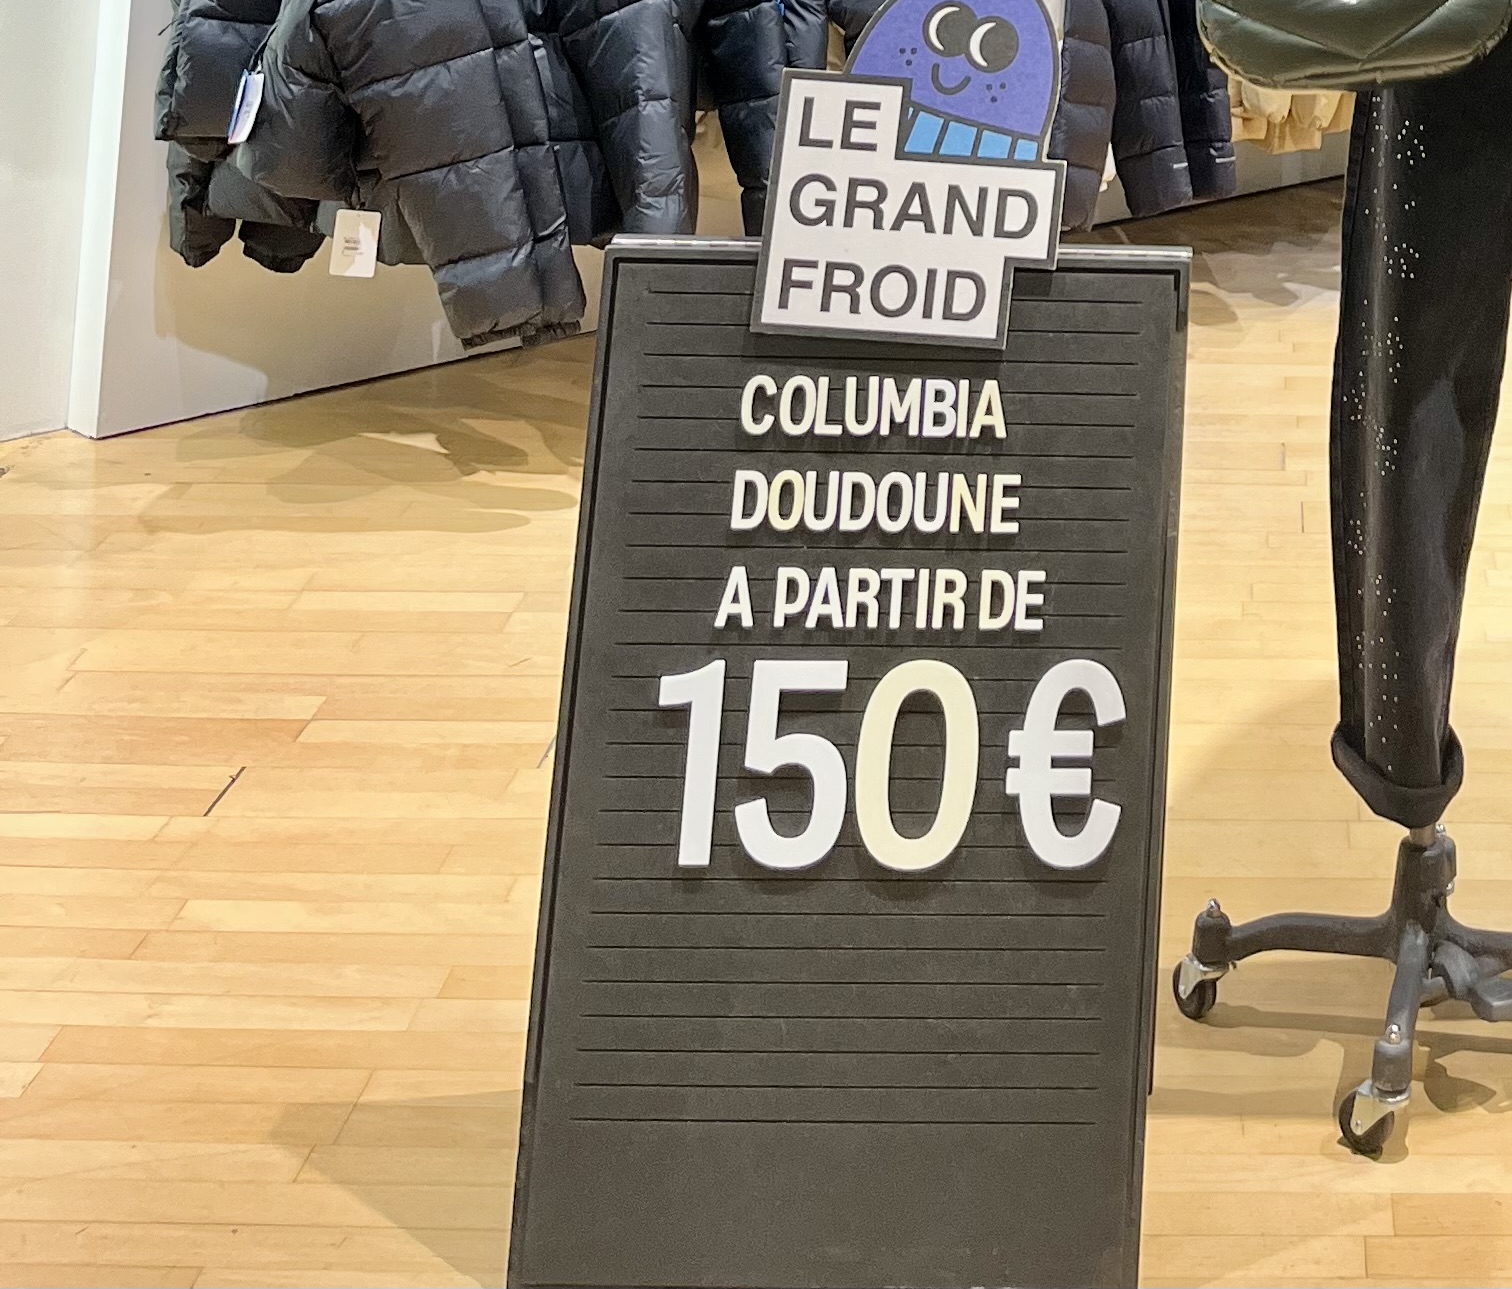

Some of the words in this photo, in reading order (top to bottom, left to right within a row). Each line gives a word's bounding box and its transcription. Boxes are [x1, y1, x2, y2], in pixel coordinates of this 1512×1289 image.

[798, 96, 882, 152] LE
[789, 173, 1039, 239] GRAND
[777, 257, 987, 322] FROID
[740, 374, 1008, 439] COLUMBIA
[730, 469, 1022, 534] DOUDOUNE
[713, 566, 754, 629] A
[773, 566, 968, 631] PARTIR
[978, 569, 1047, 632] DE
